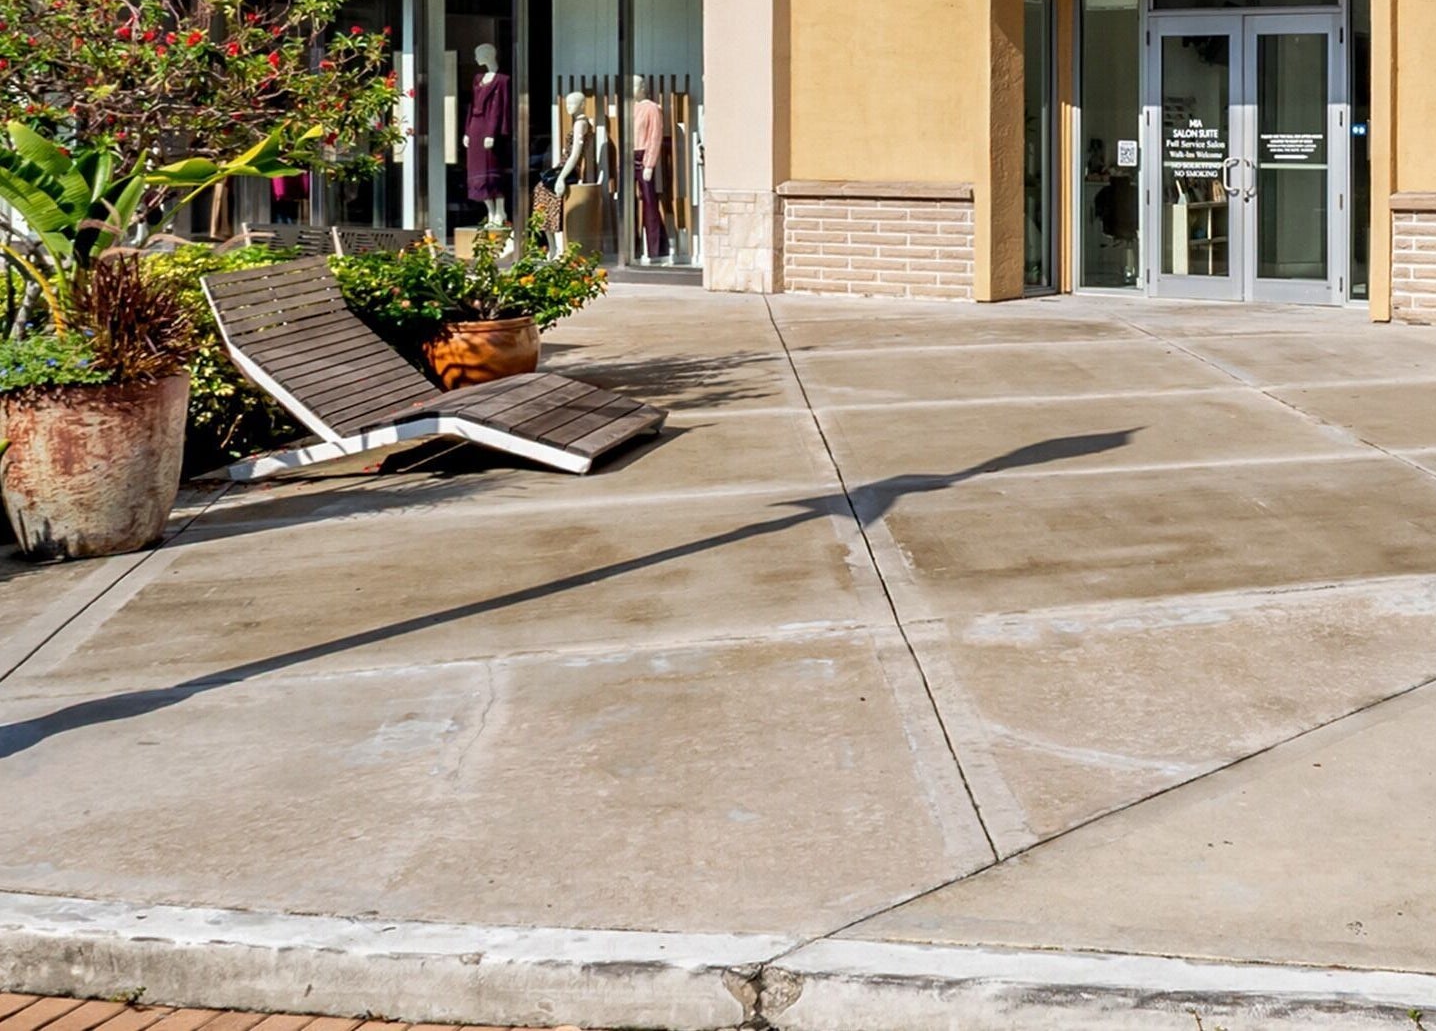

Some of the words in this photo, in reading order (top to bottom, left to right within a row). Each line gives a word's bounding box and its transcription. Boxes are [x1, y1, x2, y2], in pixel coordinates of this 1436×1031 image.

[1189, 119, 1203, 128] MIA
[1173, 129, 1198, 138] SALON
[1199, 129, 1218, 138] SUITE
[1166, 139, 1180, 148] Full
[1181, 139, 1205, 149] Service
[1206, 139, 1225, 149] Salon
[1174, 170, 1185, 178] NO
[1186, 170, 1218, 178] SMOKING
